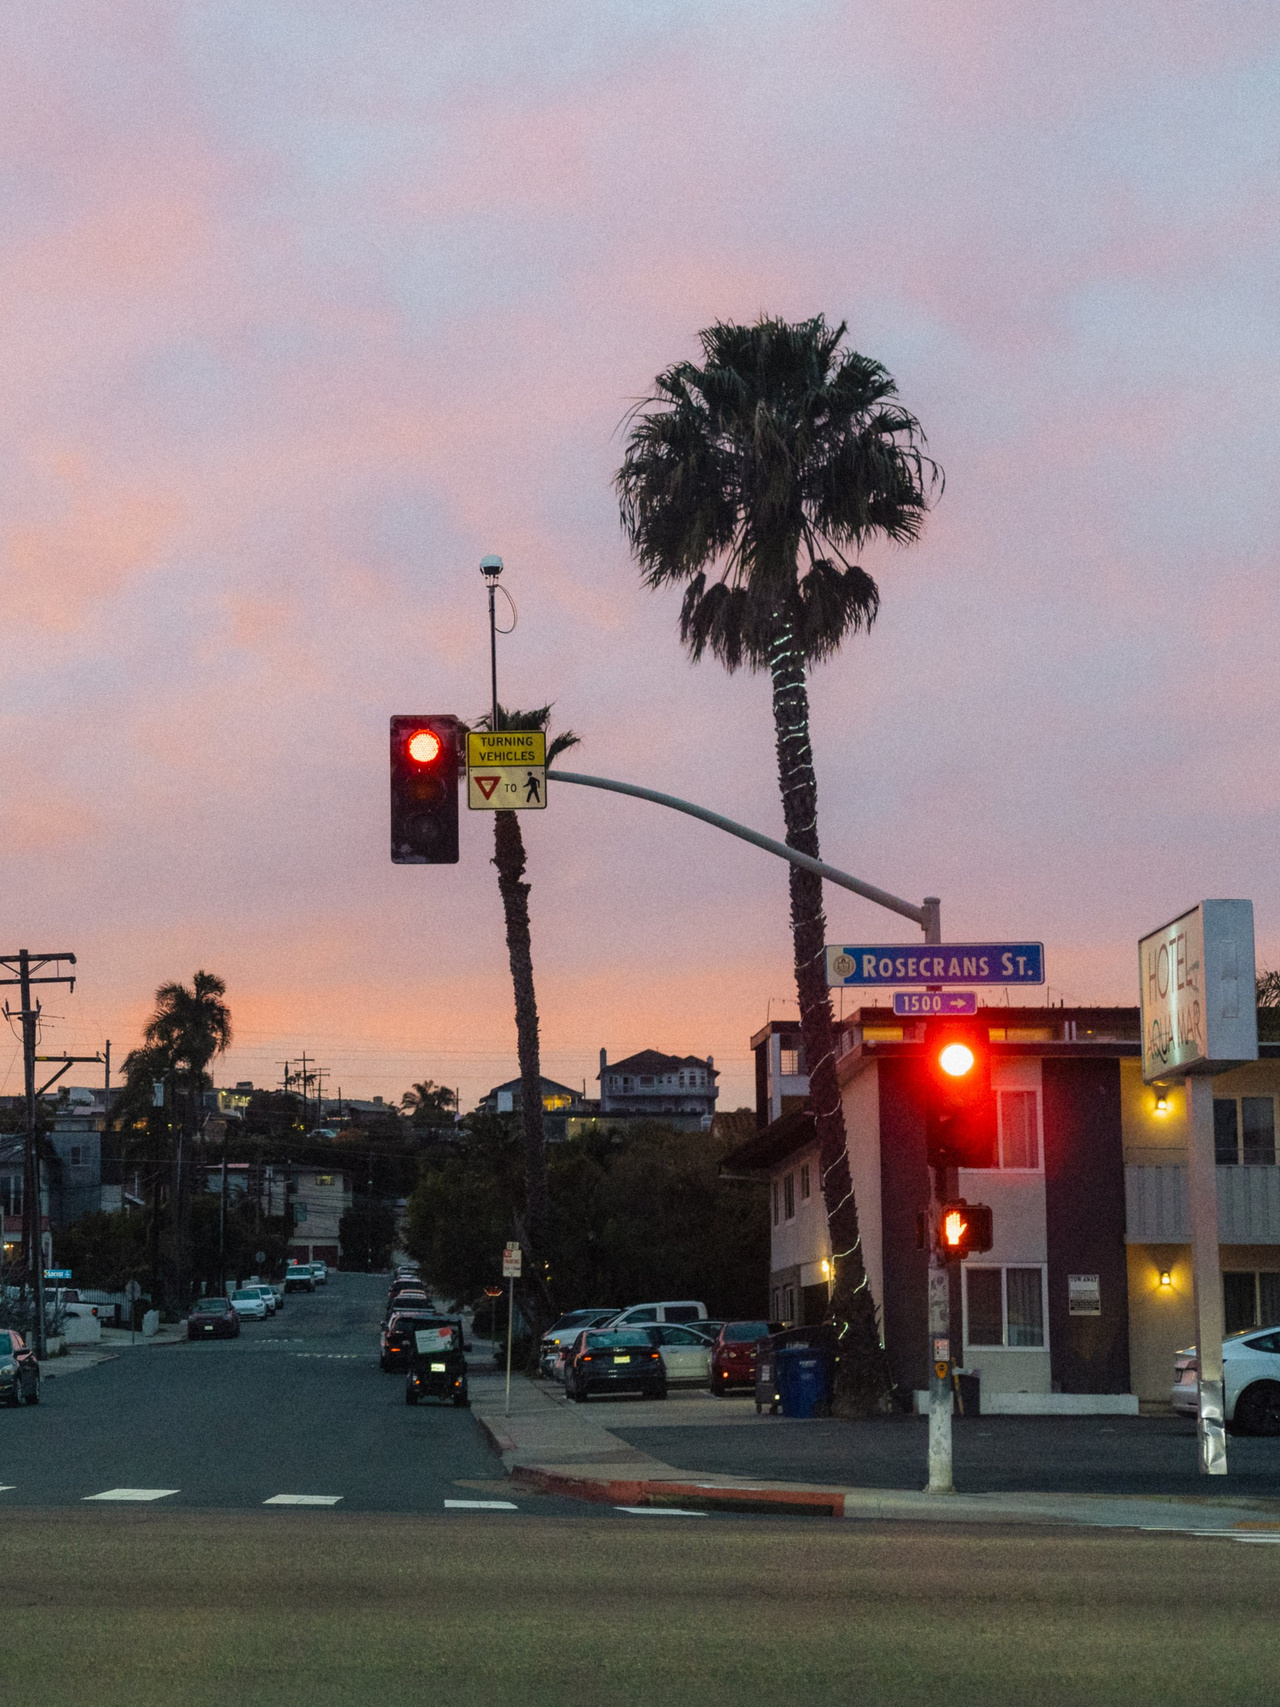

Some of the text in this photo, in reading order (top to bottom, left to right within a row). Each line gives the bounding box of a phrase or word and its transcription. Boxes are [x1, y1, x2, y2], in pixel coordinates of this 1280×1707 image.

[480, 736, 533, 747] TURNING
[479, 751, 535, 761] VEHICLES
[504, 783, 517, 793] TO
[862, 953, 990, 978] ROSECRANS
[1148, 931, 1193, 1005] HOTEL
[903, 995, 942, 1011] 1500
